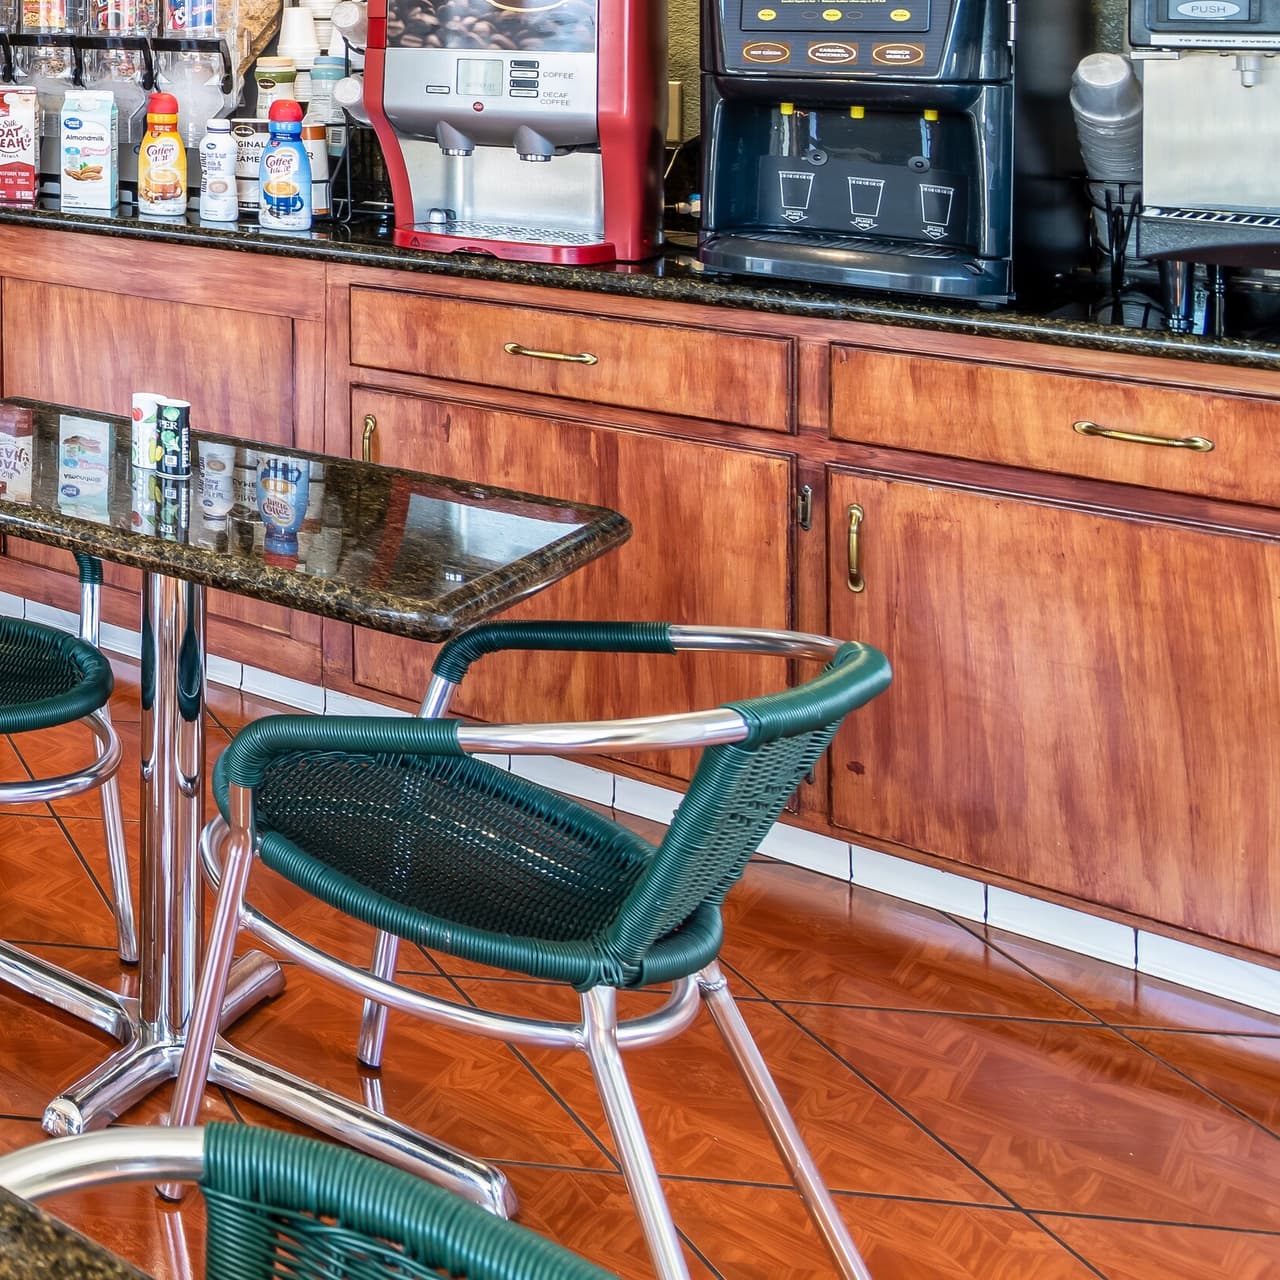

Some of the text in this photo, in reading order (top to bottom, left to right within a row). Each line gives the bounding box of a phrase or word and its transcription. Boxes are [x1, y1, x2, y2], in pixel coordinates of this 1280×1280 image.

[1191, 5, 1226, 13] PUSH
[542, 71, 574, 79] COFFEE
[65, 134, 105, 142] Almondmilk
[238, 140, 266, 148] GINAL
[265, 154, 293, 169] Coffee
